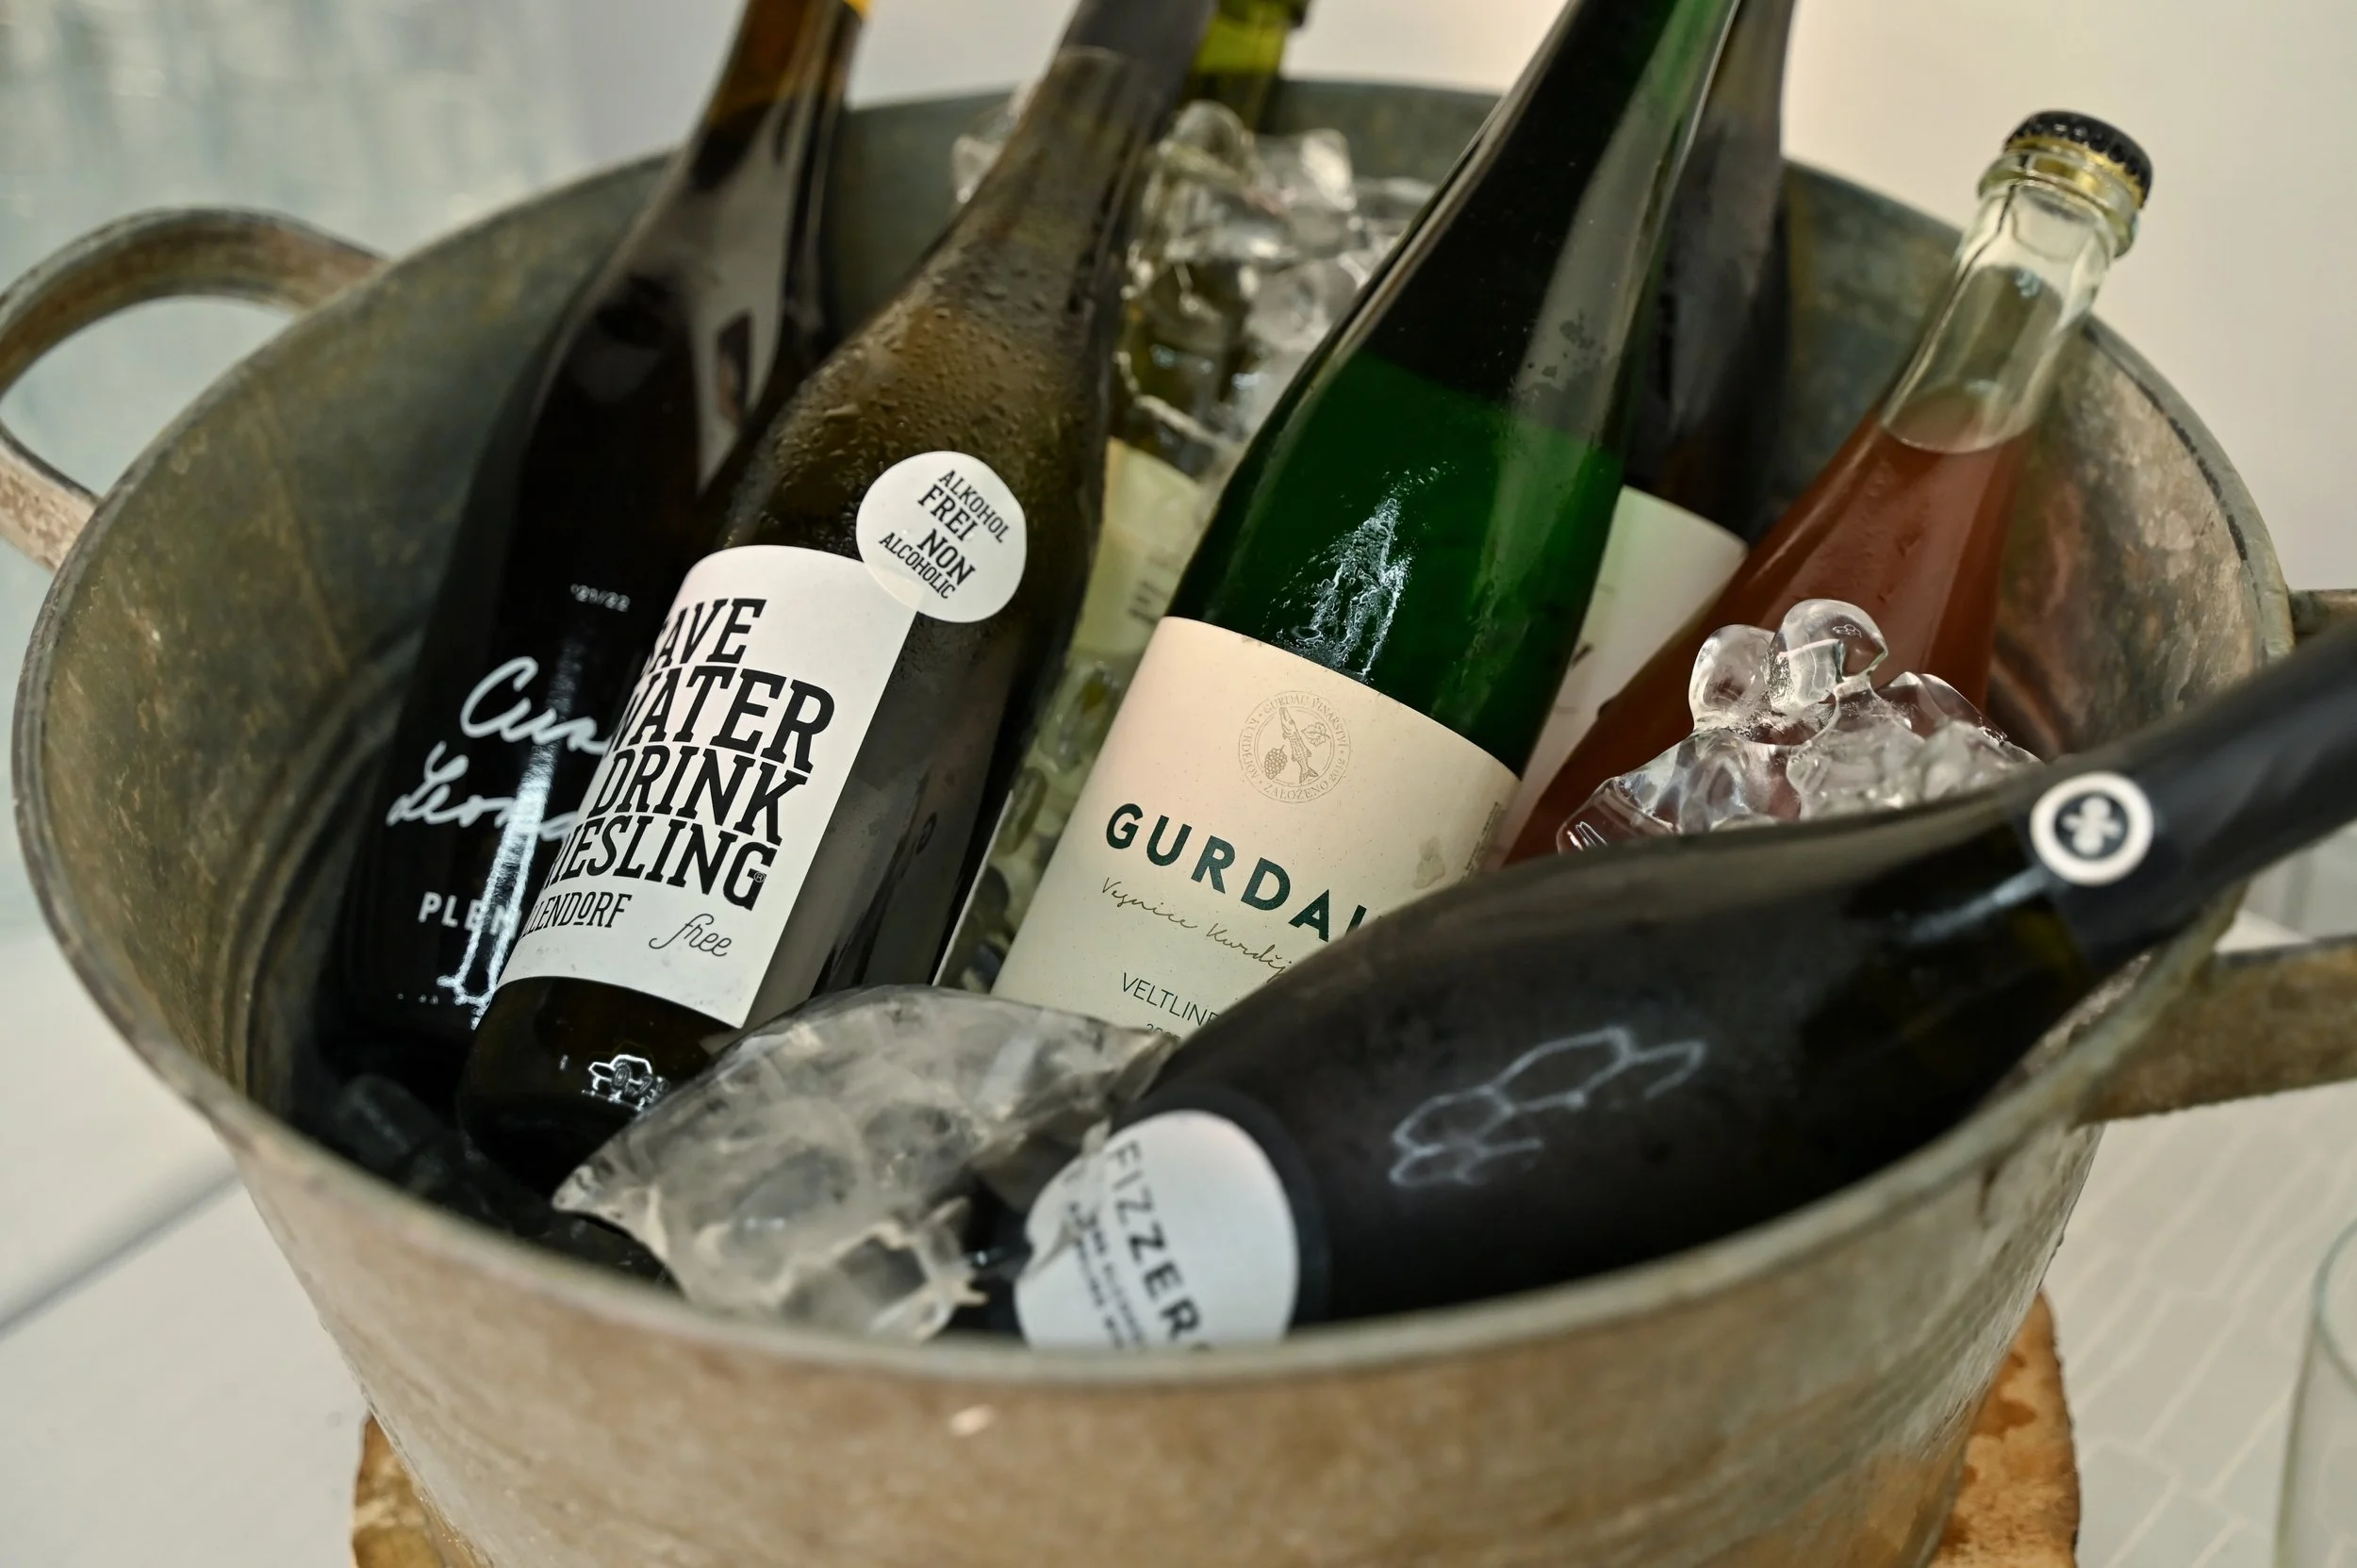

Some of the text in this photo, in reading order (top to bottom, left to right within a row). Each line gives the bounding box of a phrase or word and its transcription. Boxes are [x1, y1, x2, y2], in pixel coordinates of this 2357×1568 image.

[917, 484, 978, 542] FREI
[938, 470, 1010, 543] ALKOHOL
[879, 532, 956, 599] ALCOHOLIC
[916, 528, 977, 586] NON
[641, 598, 767, 676] AVE
[586, 745, 809, 847] DRINK
[649, 913, 733, 957] free
[1108, 1139, 1214, 1353] FIZZER
